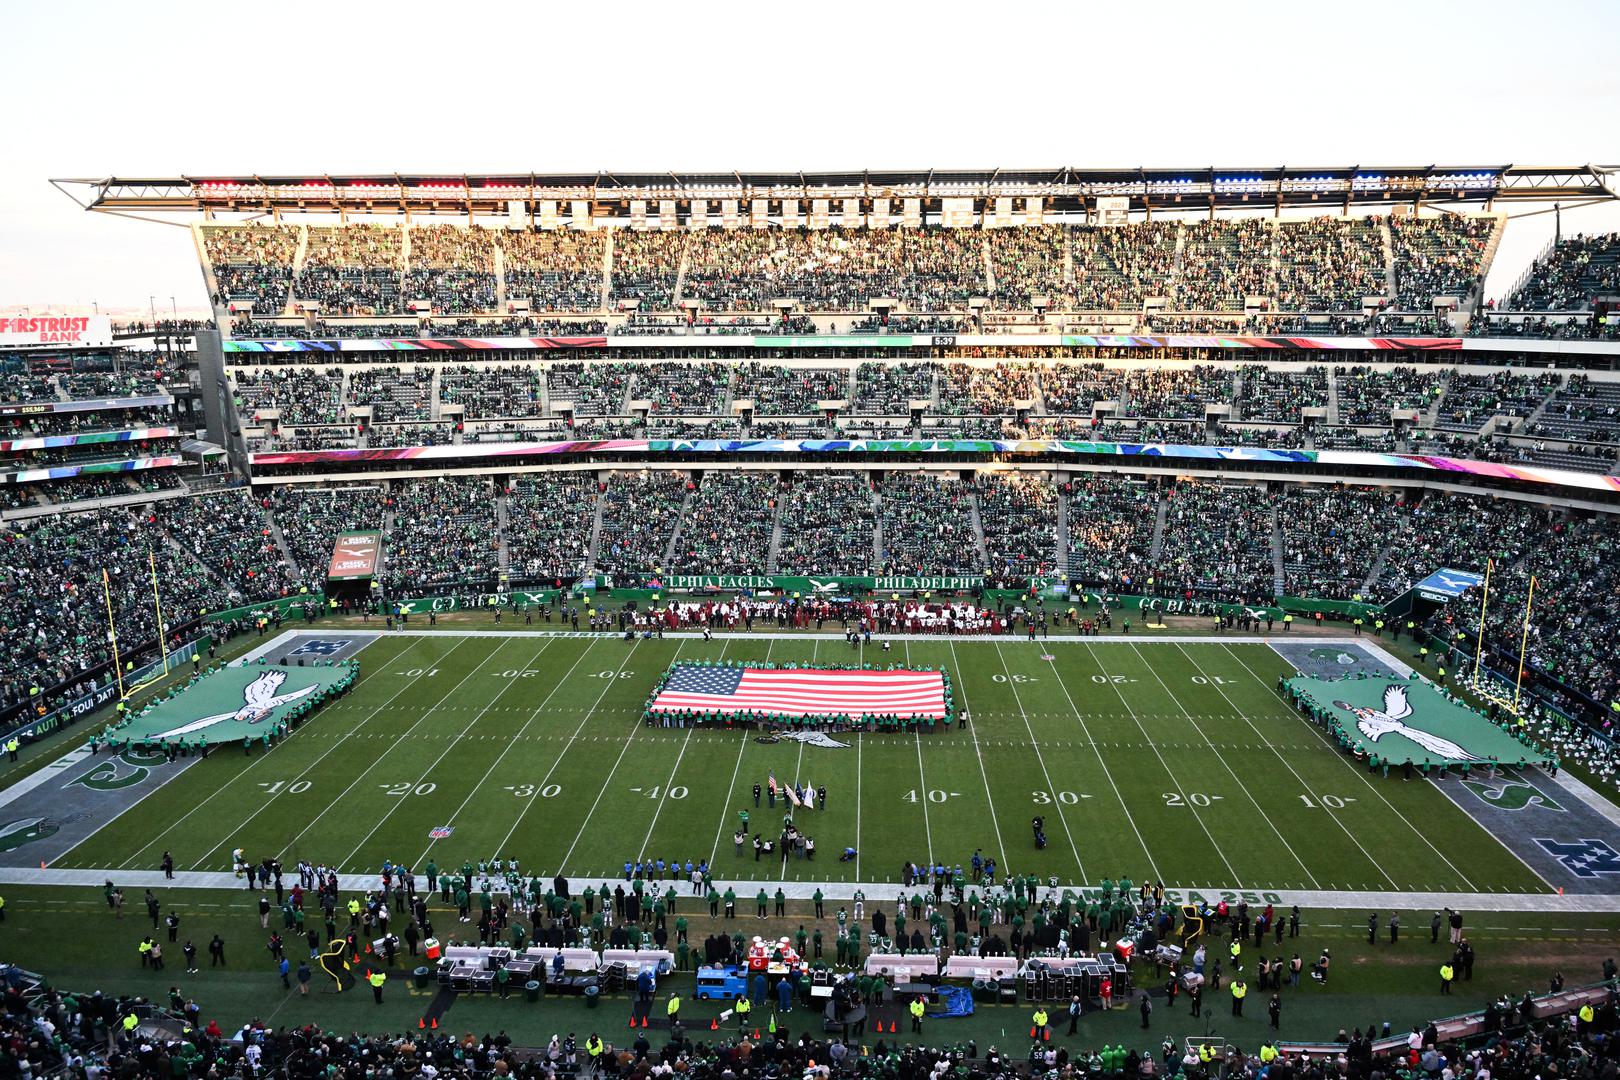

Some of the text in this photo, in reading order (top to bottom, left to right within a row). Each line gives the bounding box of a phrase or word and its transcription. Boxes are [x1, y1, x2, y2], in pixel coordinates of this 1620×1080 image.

[40, 332, 81, 342] BANK
[935, 337, 953, 345] 5:39
[1442, 568, 1484, 580] GEICO
[718, 577, 774, 588] EAGLES
[1418, 584, 1460, 597] GEICO
[1420, 591, 1449, 602] GEICO
[264, 780, 313, 794] 10
[386, 782, 437, 796] 20
[514, 784, 562, 798] 30
[643, 786, 689, 800] 40
[902, 789, 948, 803] 40
[1032, 791, 1079, 805] 30
[1162, 792, 1211, 807] 20
[1298, 794, 1345, 809] 10
[1219, 891, 1283, 905] 250
[753, 958, 762, 967] G
[1034, 1052, 1043, 1060] 59
